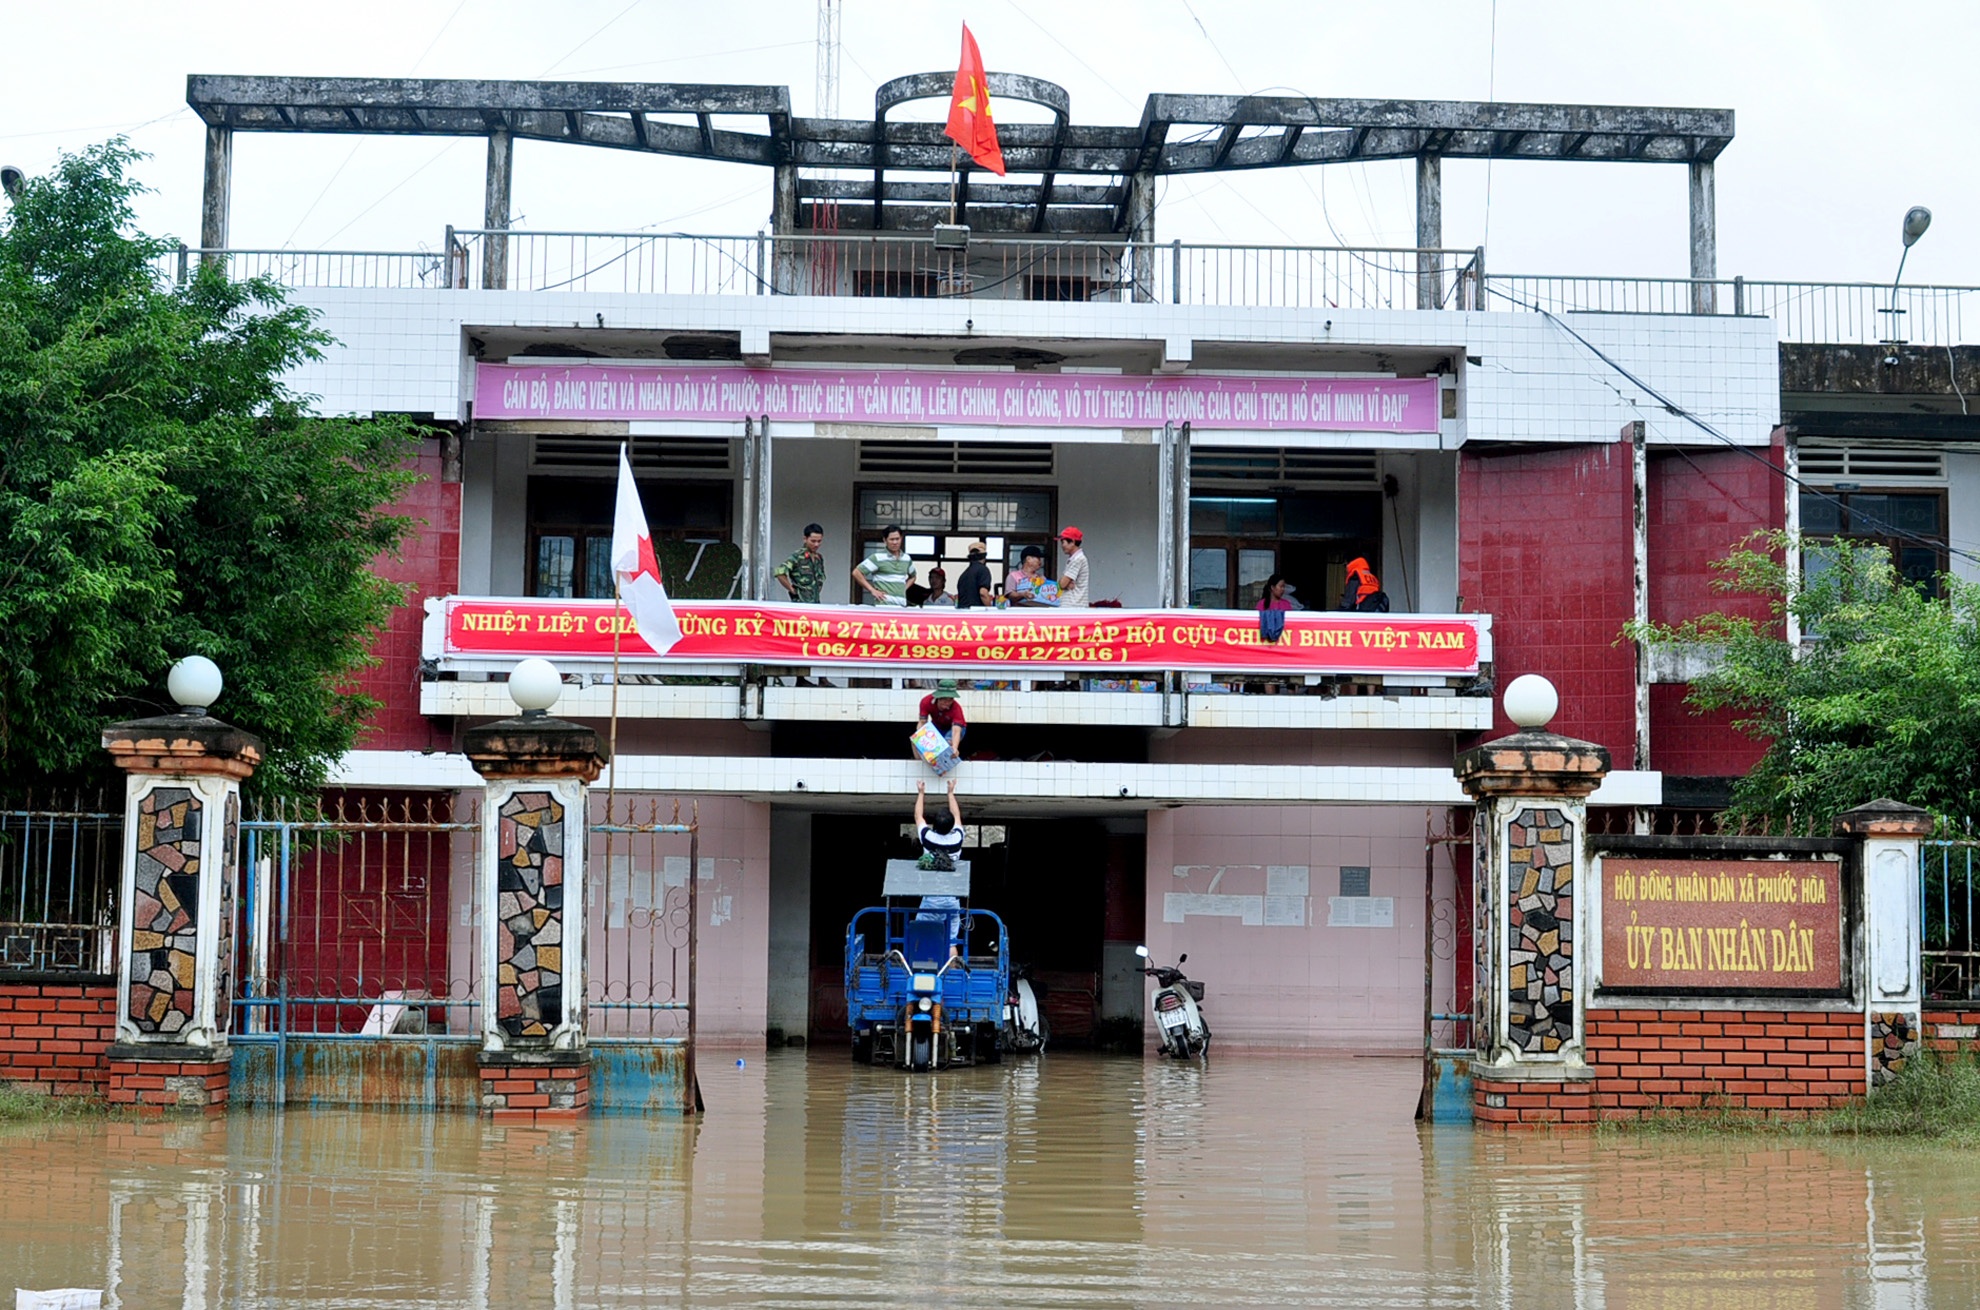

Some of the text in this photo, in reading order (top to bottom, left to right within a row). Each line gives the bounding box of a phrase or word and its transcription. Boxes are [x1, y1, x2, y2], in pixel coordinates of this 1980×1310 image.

[504, 372, 527, 409] CÁN
[531, 373, 550, 416] BỘ,
[553, 370, 586, 411] ĐẢNG
[589, 373, 616, 411] VIÊN
[620, 374, 635, 411] VÀ
[639, 374, 671, 411] NHÂN
[675, 375, 698, 412] DÂN
[701, 375, 717, 412] XÃ
[720, 375, 760, 412] PHƯỚC
[764, 377, 788, 413] HÒA
[791, 379, 822, 419] THỰC
[826, 377, 854, 420] HIỆN
[891, 378, 925, 420] KIỆM,
[929, 379, 957, 416] LIÊM
[961, 380, 1000, 422] CHÍNH,
[1004, 381, 1024, 417] CHÍ
[1027, 381, 1062, 423] CÔNG,
[1065, 382, 1081, 418] VÔ
[1083, 384, 1101, 419] TƯ
[1102, 390, 1133, 419] THEO
[1136, 380, 1162, 419] TẤM
[1166, 385, 1204, 420] GƯƠNG
[1208, 381, 1231, 421] CỦA
[1234, 382, 1258, 421] CHỦ
[1261, 393, 1288, 428] TỊCH
[1292, 380, 1308, 422] HỒ
[1311, 385, 1332, 422] CHÍ
[1334, 394, 1364, 423] MINH
[1367, 386, 1380, 422] VĨ
[461, 610, 531, 635] NHIỆT
[537, 611, 588, 637] LIỆT
[677, 612, 728, 635] ỪNG
[734, 612, 766, 637] KỶ
[772, 616, 830, 642] NIỆM
[837, 621, 864, 639] 27
[870, 618, 919, 640] NĂM
[927, 620, 988, 642] NGÀY
[993, 622, 1070, 642] THÀNH
[1077, 621, 1120, 647] LẬP
[1125, 622, 1166, 647] HỘI
[1172, 623, 1217, 649] CỰU
[1299, 630, 1352, 648] BINH
[1358, 626, 1411, 652] VIỆT
[1416, 631, 1465, 649] NAM
[1615, 869, 1826, 906] HỘI ĐỒNG NHÂN DÂN XÃ PHƯỚC HÒA
[1626, 910, 1814, 973] ỦY BAN NHÂN DÂN
